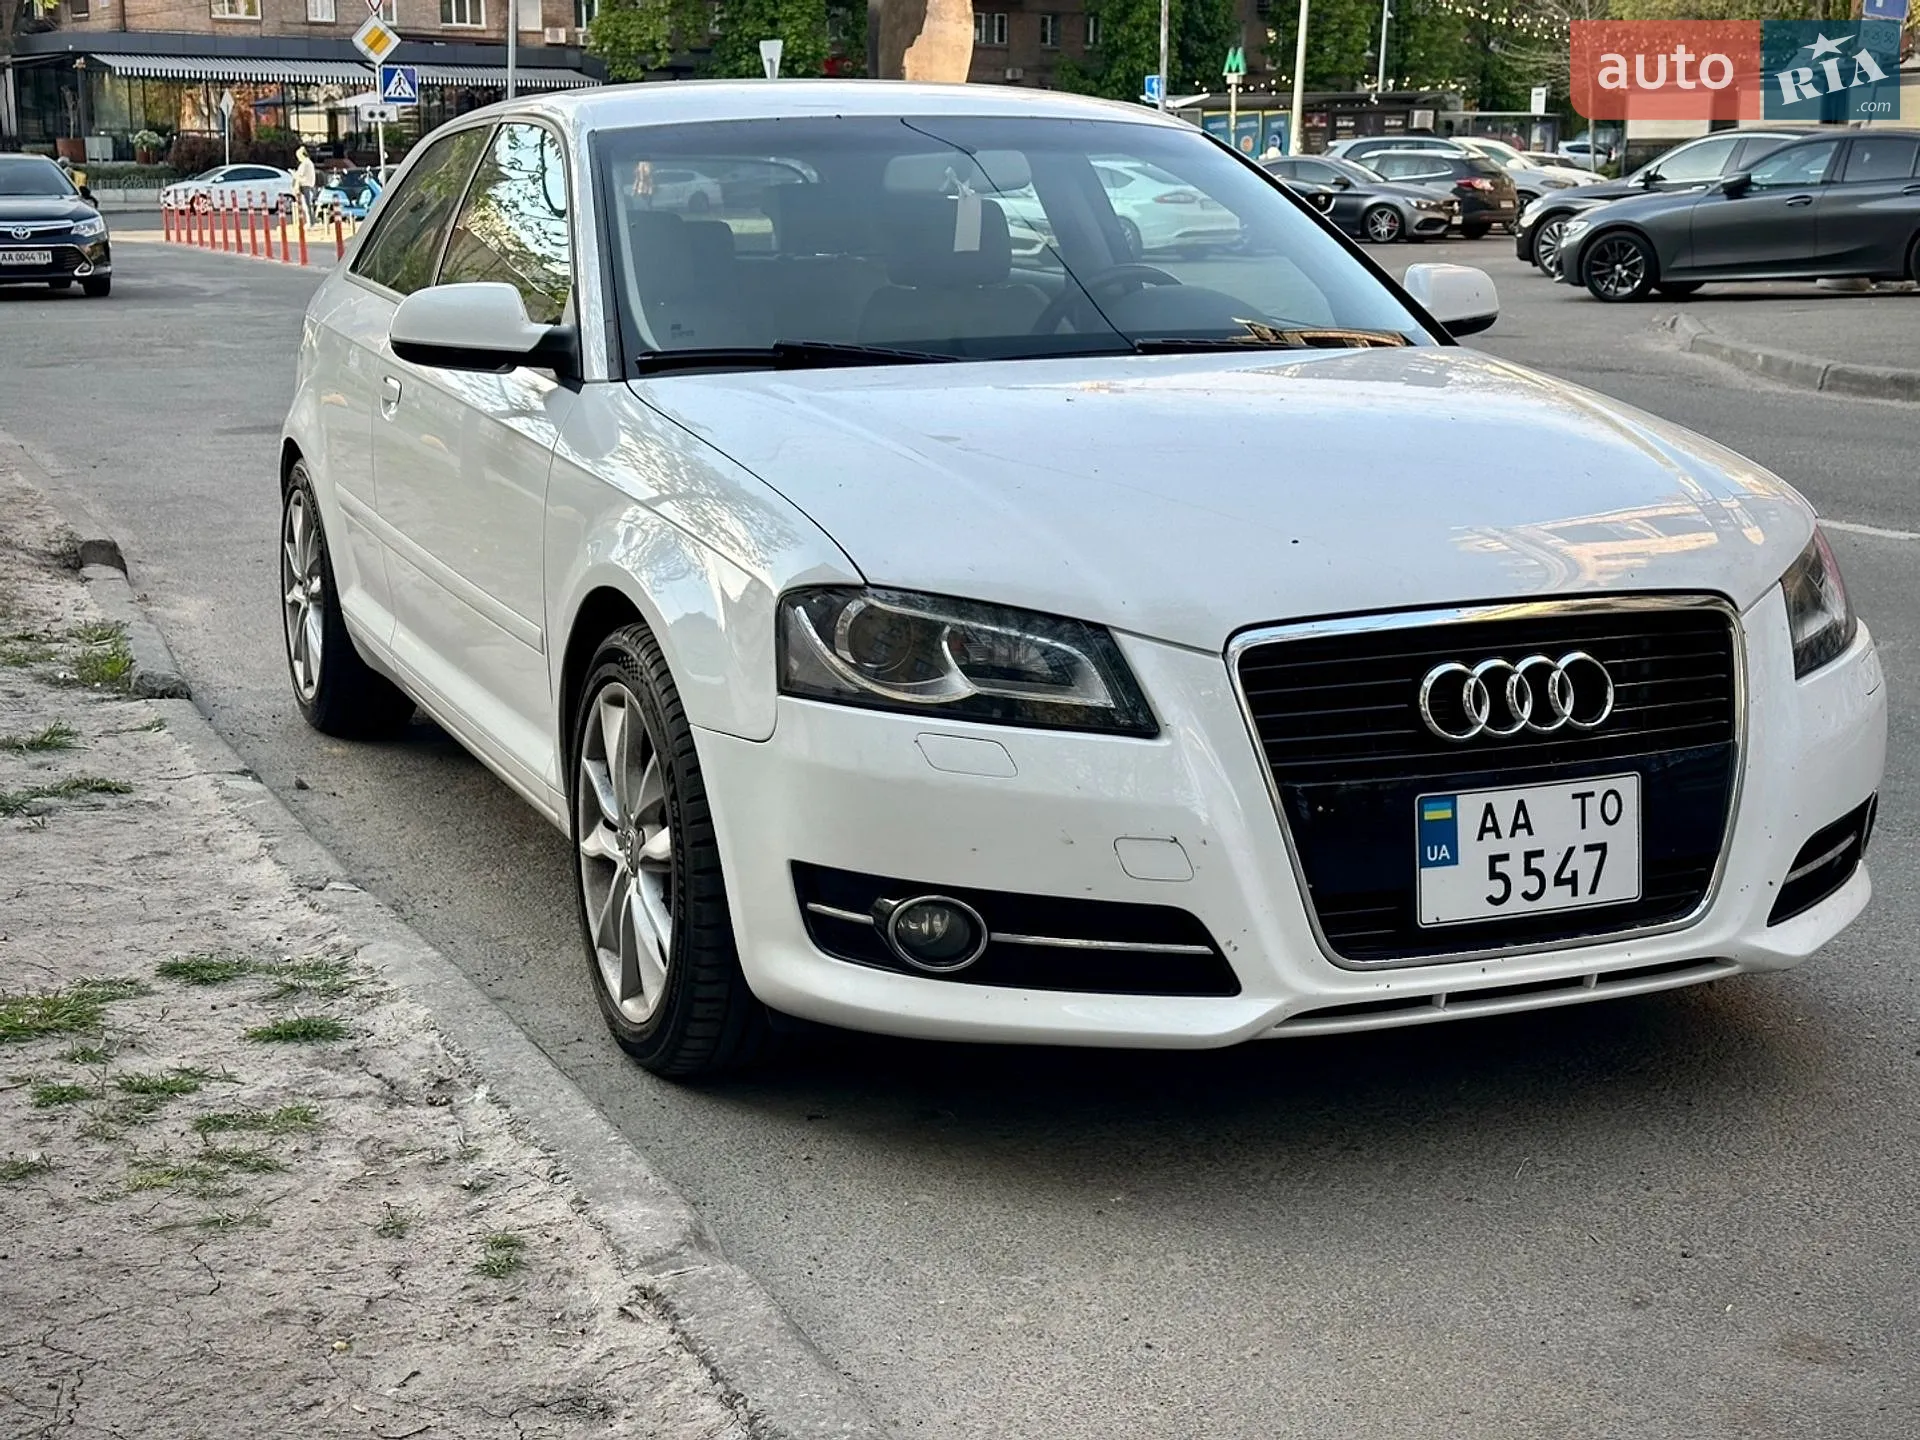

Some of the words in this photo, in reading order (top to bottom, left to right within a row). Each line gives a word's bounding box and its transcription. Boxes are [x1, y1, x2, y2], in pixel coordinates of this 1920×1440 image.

[1477, 799, 1534, 841] AA
[1571, 789, 1623, 830] TO
[1426, 845, 1451, 861] UA
[1485, 842, 1608, 906] 5547
